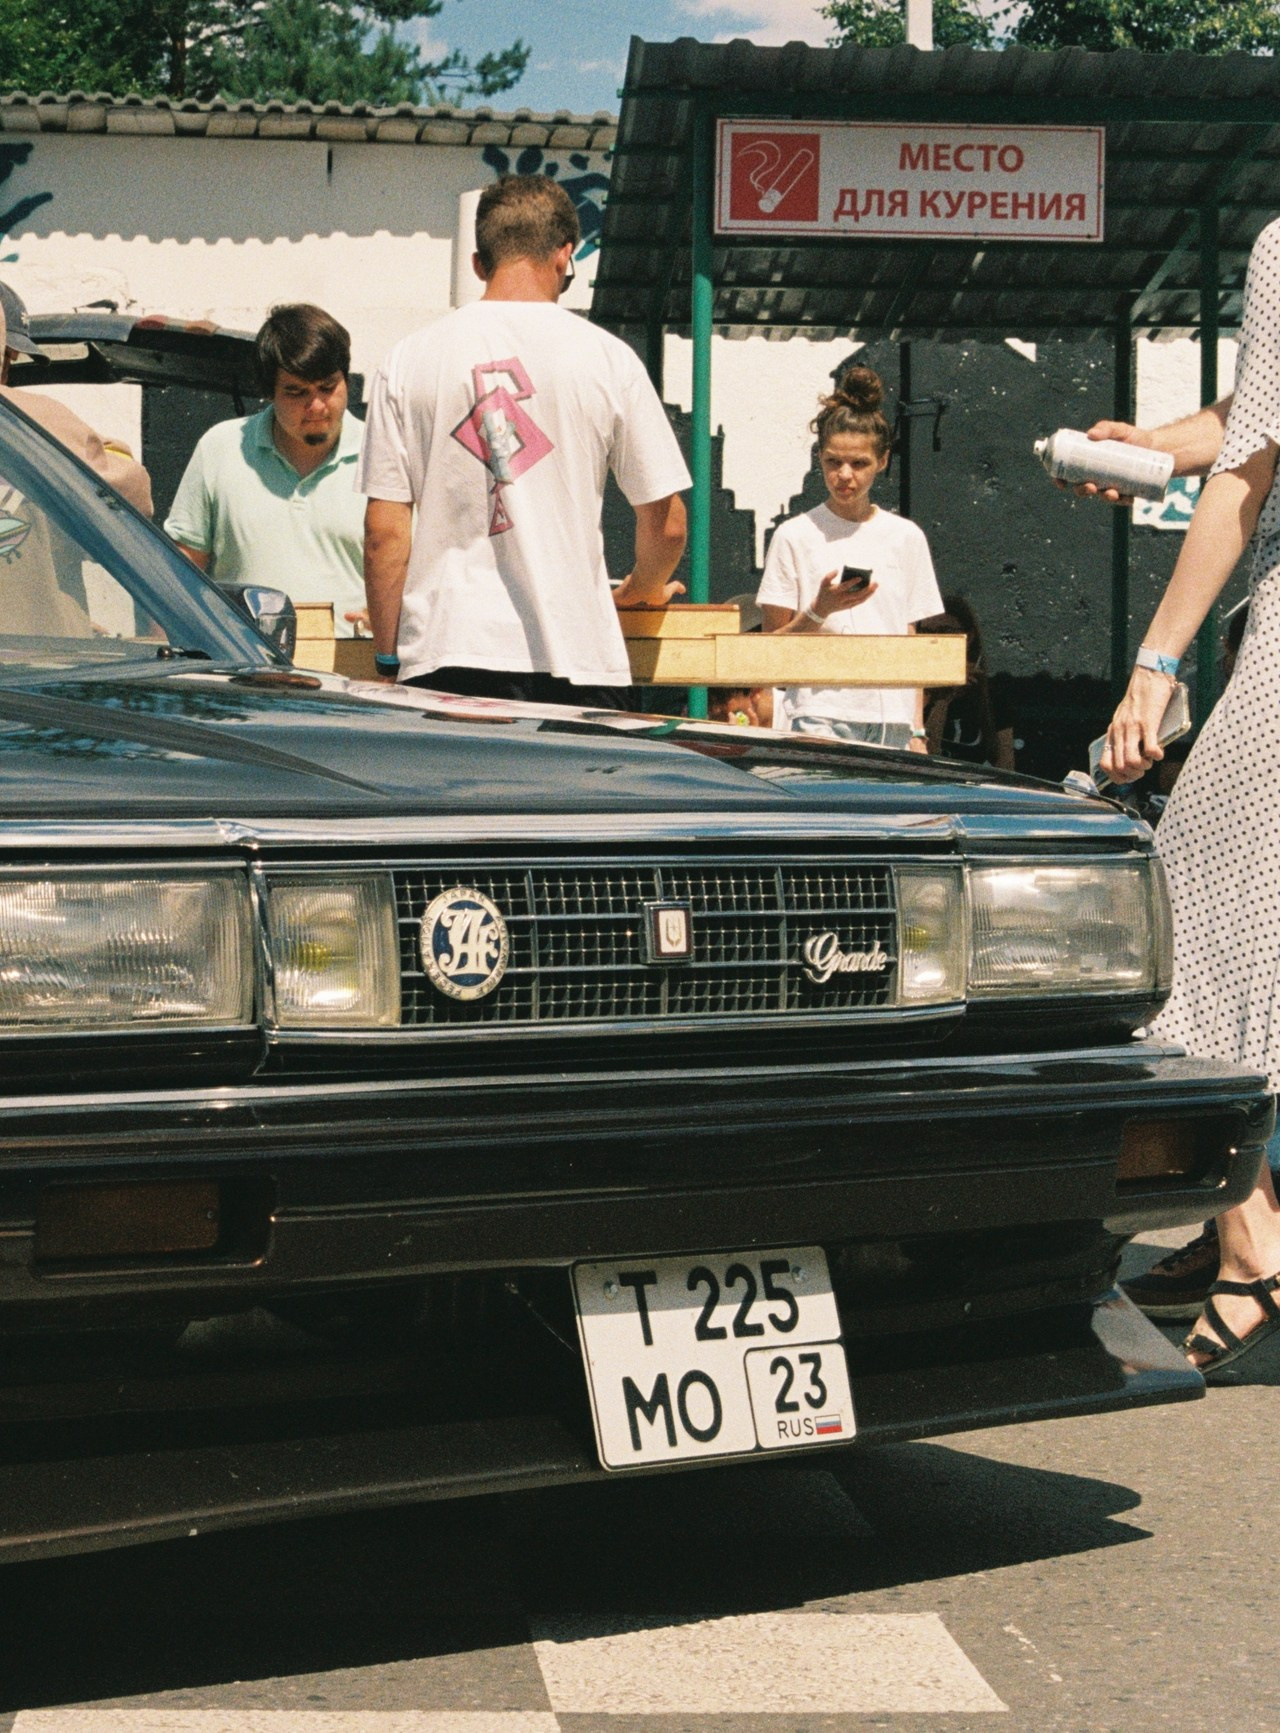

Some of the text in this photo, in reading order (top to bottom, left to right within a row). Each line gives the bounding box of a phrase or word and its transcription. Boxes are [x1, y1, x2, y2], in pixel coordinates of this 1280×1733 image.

[899, 142, 1025, 173] МЕСТО
[833, 188, 1087, 223] ДЛЯ КУРЕНИЯ
[802, 931, 888, 984] Grande
[686, 1258, 800, 1342] 225
[769, 1351, 828, 1414] 23
[776, 1417, 815, 1440] RUS
